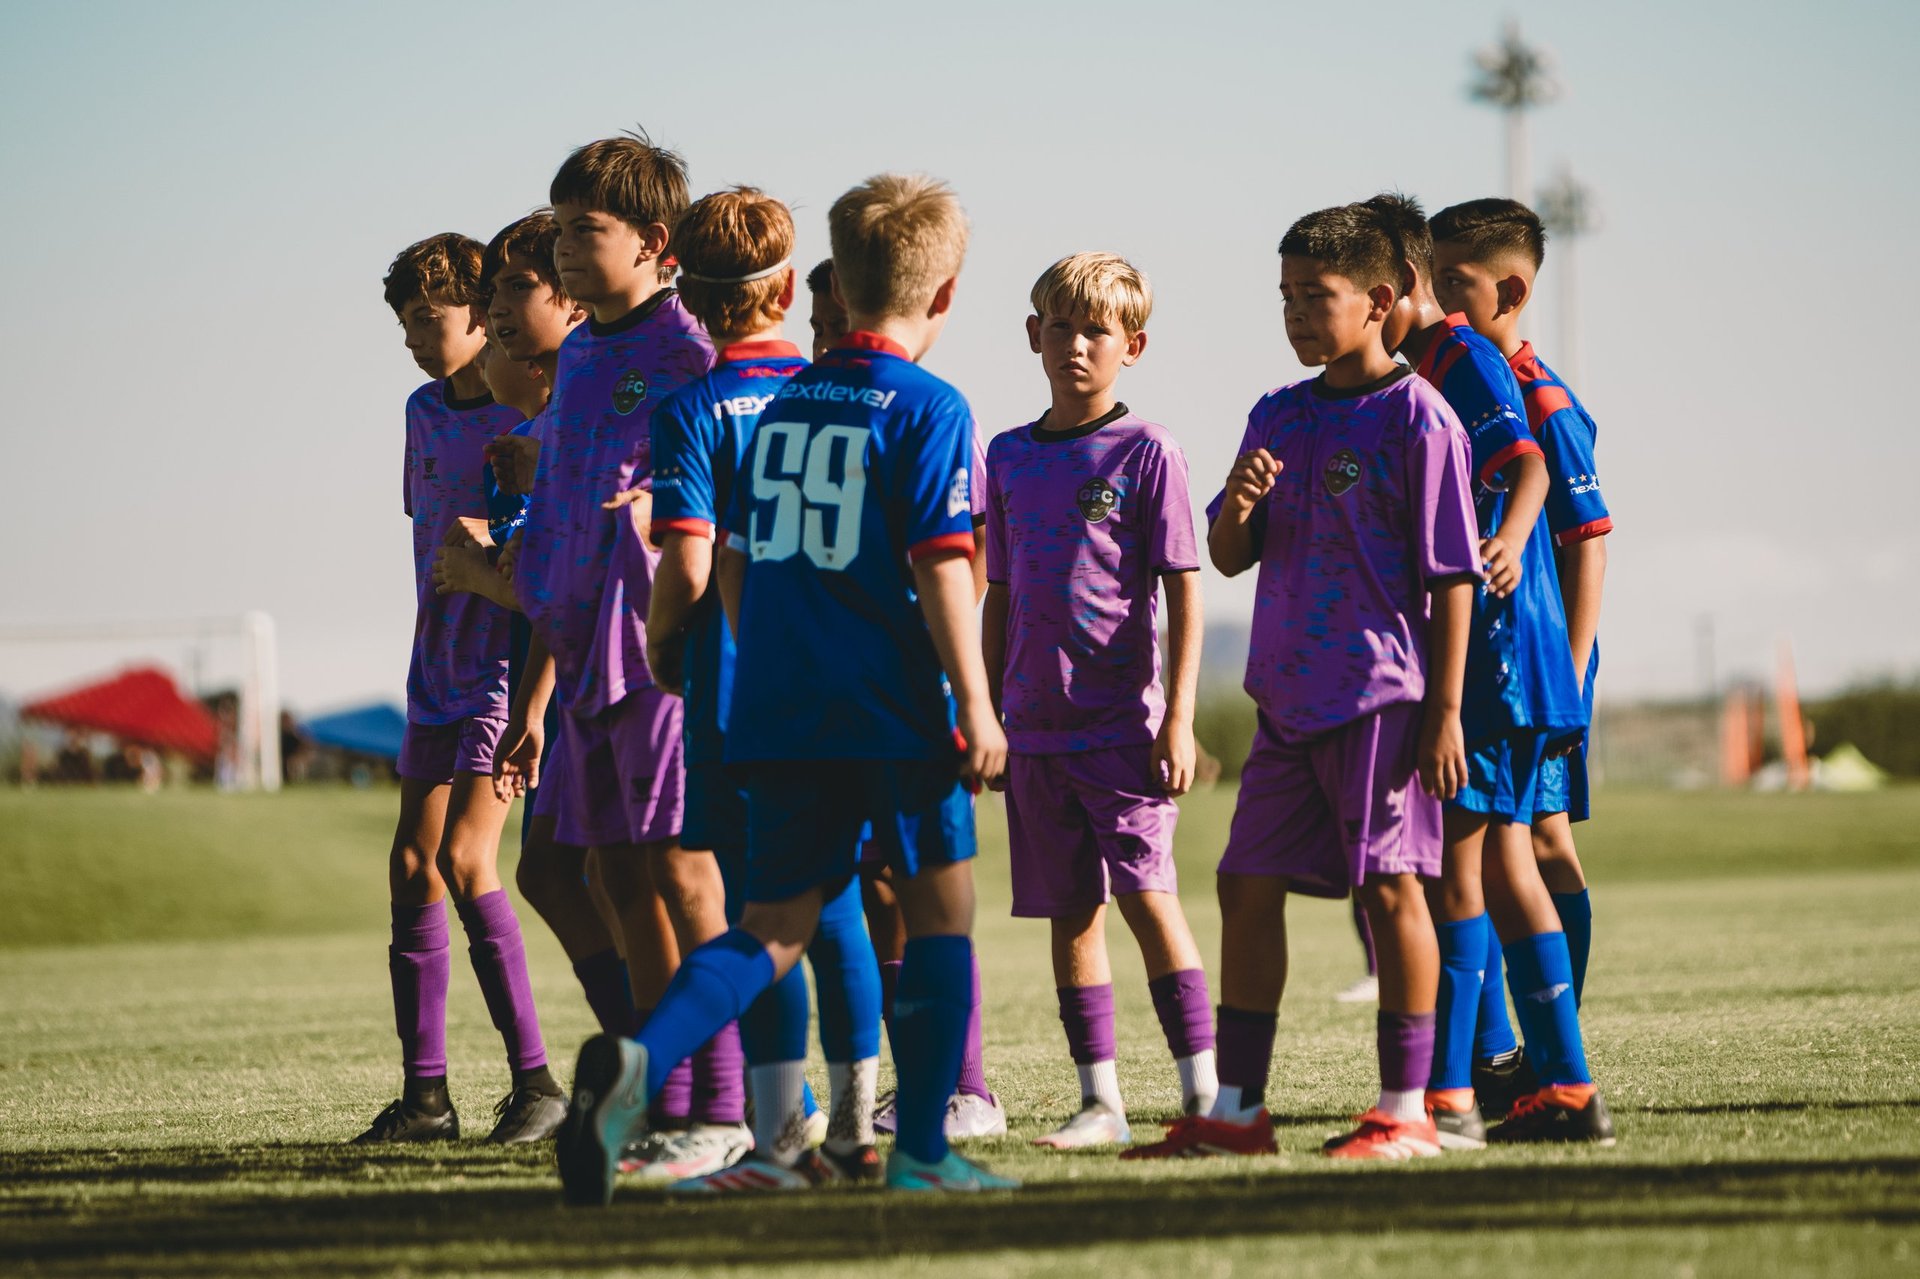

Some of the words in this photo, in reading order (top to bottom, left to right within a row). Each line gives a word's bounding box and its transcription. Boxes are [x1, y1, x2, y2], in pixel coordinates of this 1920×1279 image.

[615, 380, 645, 394] GFC
[1327, 458, 1359, 477] GFC
[1079, 488, 1114, 504] GFC
